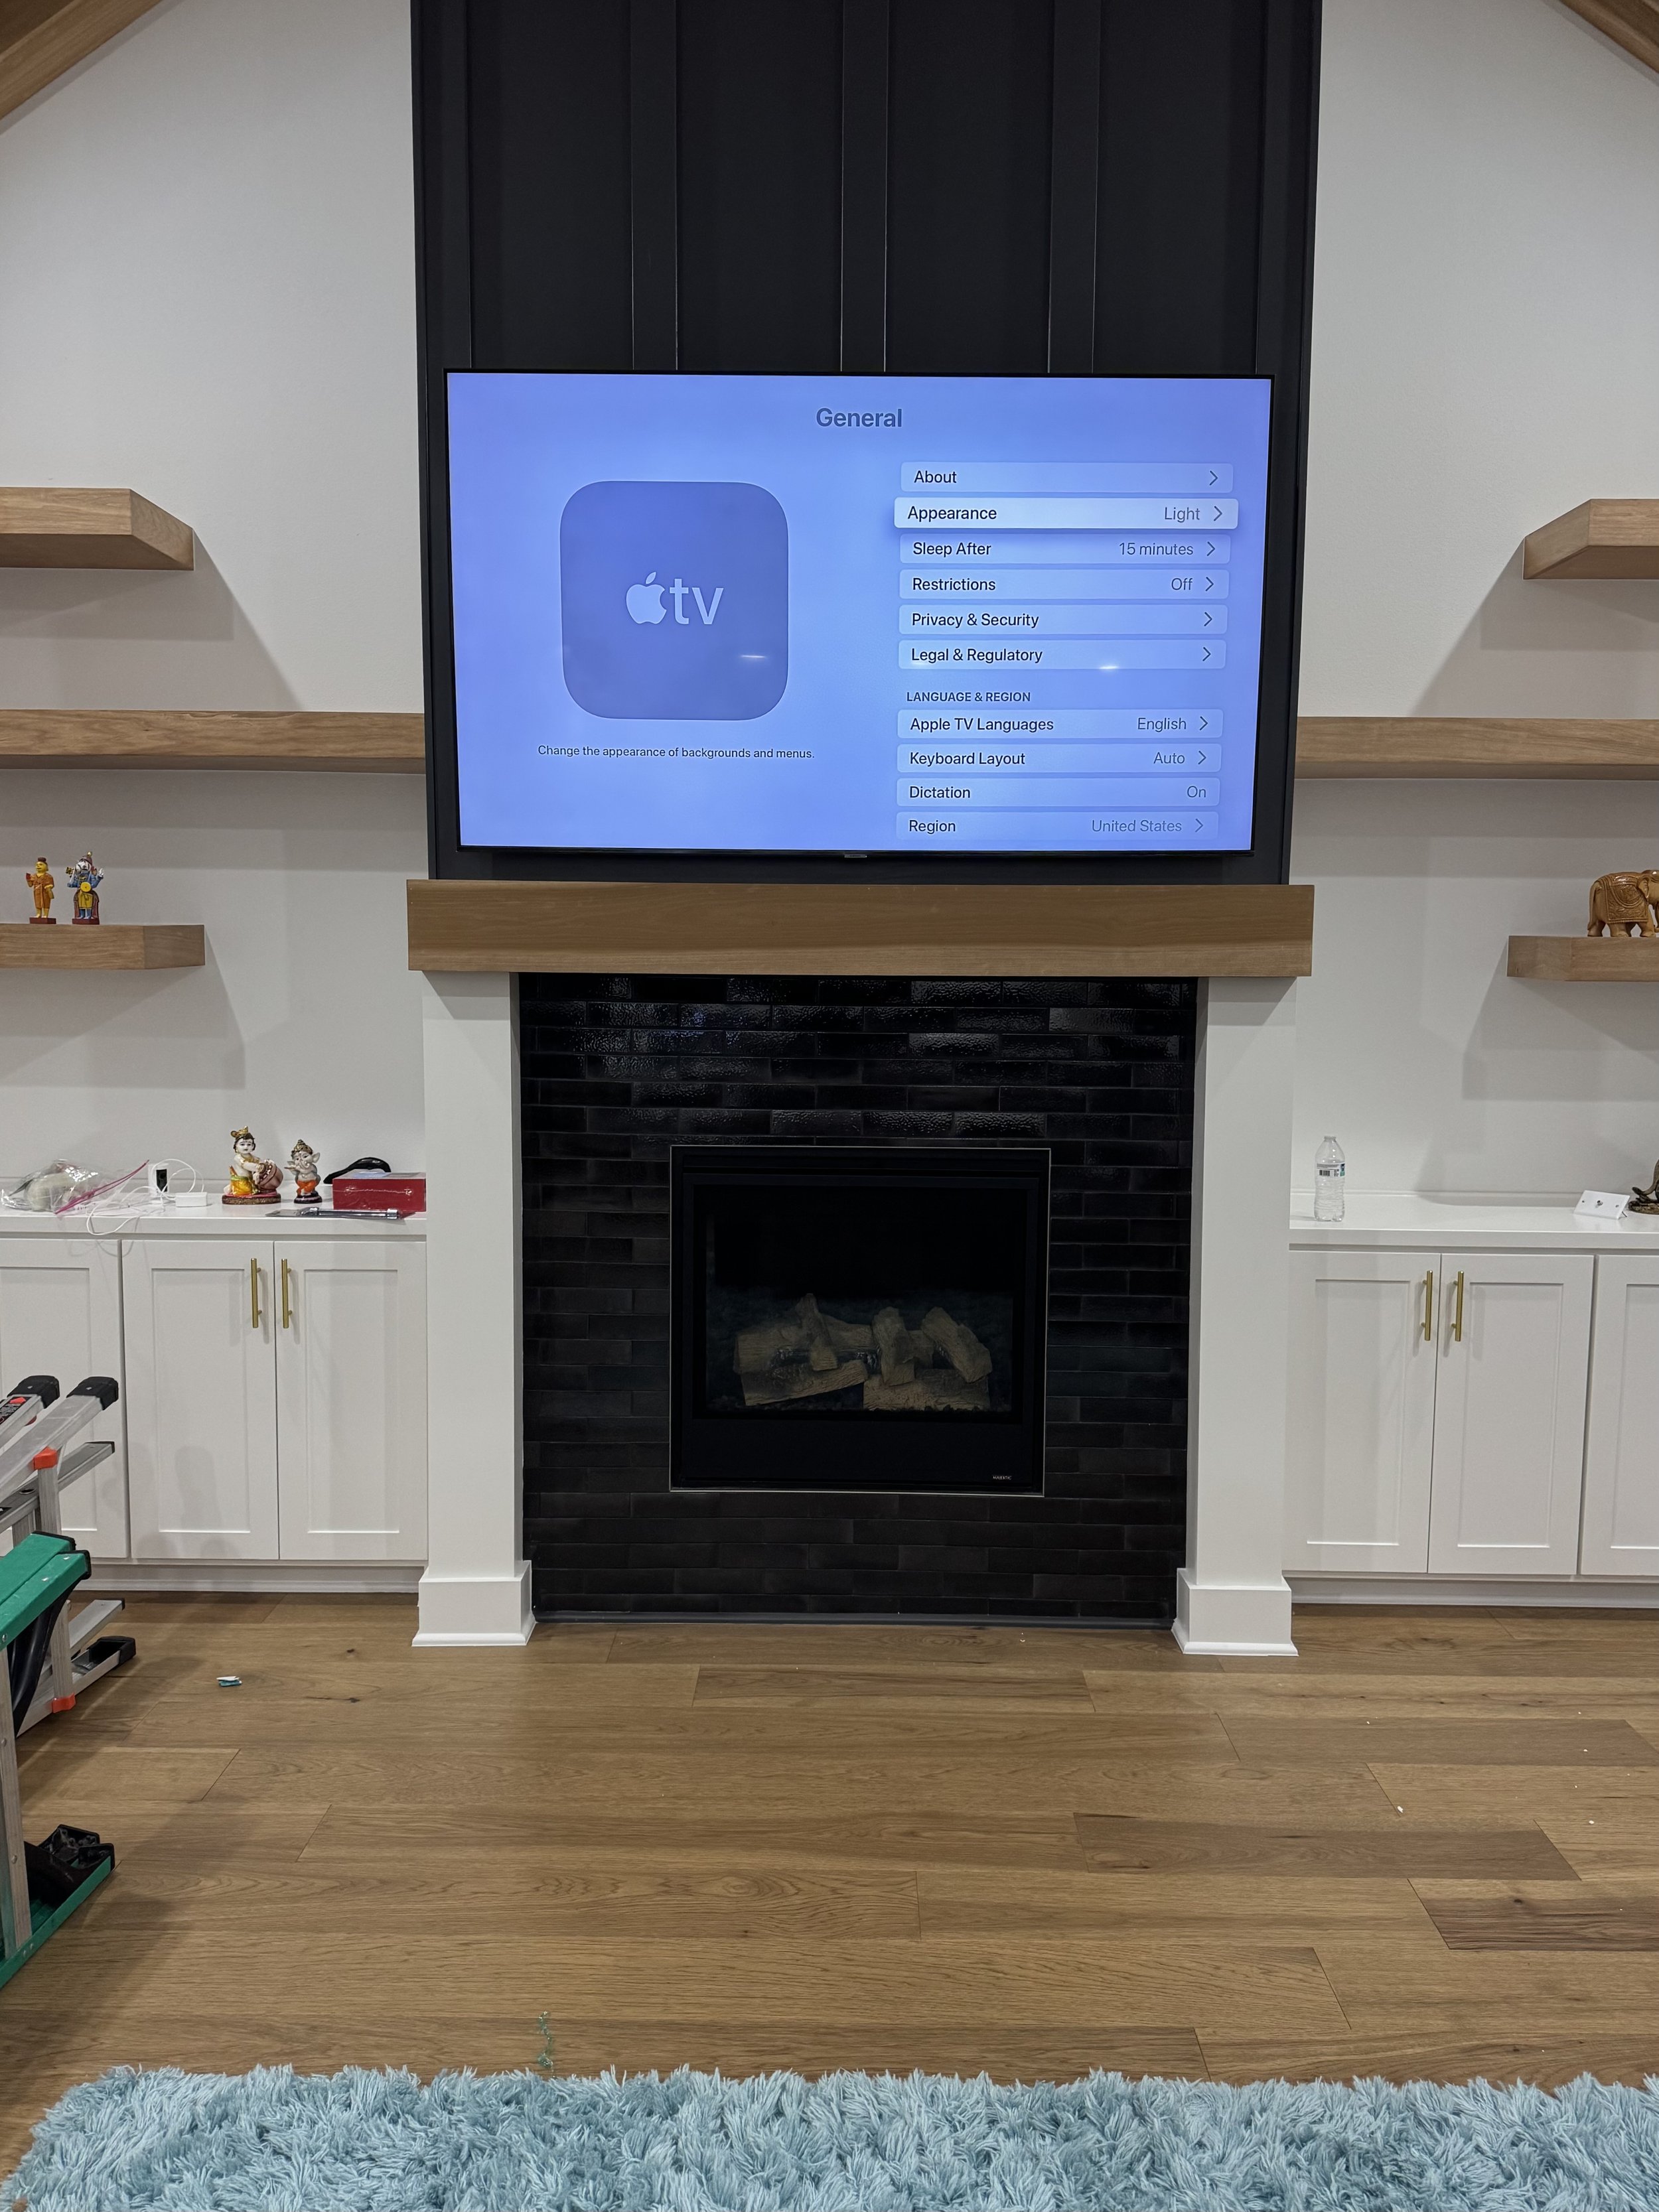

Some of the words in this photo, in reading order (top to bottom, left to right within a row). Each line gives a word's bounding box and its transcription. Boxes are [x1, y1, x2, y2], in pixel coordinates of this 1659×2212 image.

[816, 407, 902, 427] General
[914, 470, 957, 484] About
[907, 506, 997, 523] Appearance
[1165, 506, 1200, 523] Light
[913, 541, 952, 558] Sleep
[956, 542, 991, 555] After
[1119, 542, 1136, 555] 15
[1139, 542, 1193, 555] minutes
[912, 577, 996, 590] Restrictions
[1171, 577, 1193, 590] Off
[669, 578, 724, 625] tv
[912, 613, 964, 629] Privacy
[967, 613, 977, 626] &
[981, 613, 1039, 629] Security
[912, 648, 949, 664] Legal
[953, 648, 964, 661] &
[967, 648, 1043, 664] Regulatory
[906, 691, 972, 702] LANGUAGE
[974, 692, 983, 702] &
[985, 692, 1031, 702] REGION
[910, 717, 950, 733] Apple
[954, 717, 974, 730] TV
[977, 717, 1054, 733] Languages
[1137, 717, 1187, 733] English
[538, 745, 580, 758] Change
[582, 746, 600, 756] the
[603, 748, 666, 758] appearance
[668, 747, 679, 757] of
[682, 747, 751, 760] backgrounds
[753, 748, 773, 758] and
[910, 752, 975, 767] Keyboard
[979, 752, 1026, 767] Layout
[1153, 752, 1185, 764] Auto
[910, 786, 970, 799] Dictation
[1187, 786, 1206, 798] On
[909, 819, 956, 835] Region
[1092, 819, 1136, 832] United
[1140, 819, 1182, 832] States
